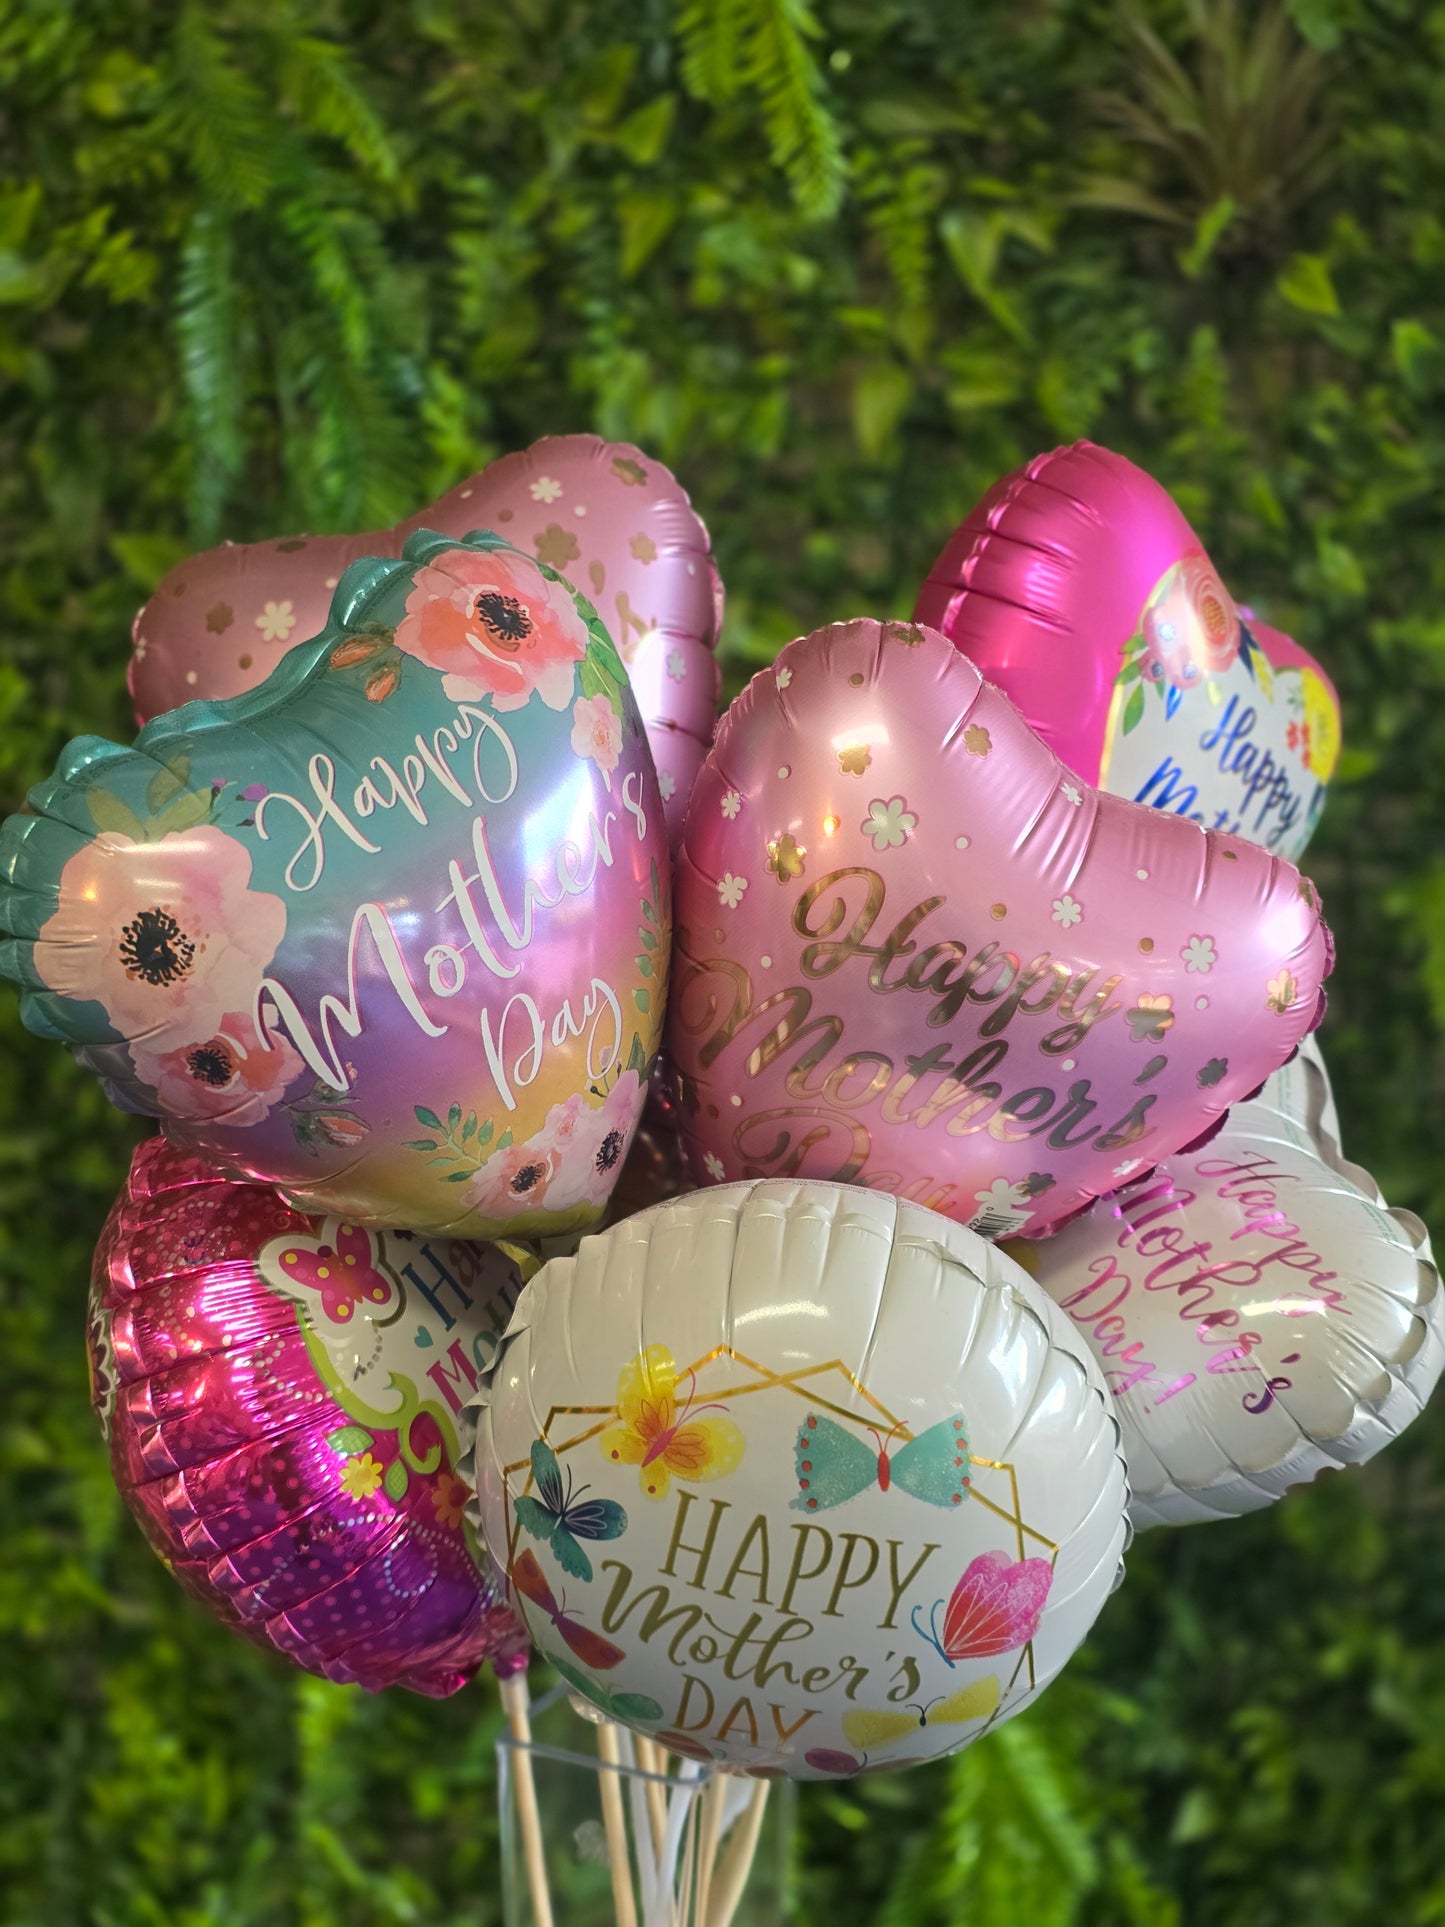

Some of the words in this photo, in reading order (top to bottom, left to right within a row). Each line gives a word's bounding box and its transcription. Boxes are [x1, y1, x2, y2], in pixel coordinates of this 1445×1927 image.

[254, 704, 519, 892] Happy
[1198, 693, 1302, 848] Happy
[791, 866, 1125, 1055] Happy
[480, 978, 623, 1111] Day
[680, 958, 1168, 1153] Mother's
[1195, 1151, 1352, 1318] Happy
[1059, 1255, 1197, 1415] Day!
[657, 1488, 942, 1630] HAPPY
[668, 1673, 823, 1754] DAY
